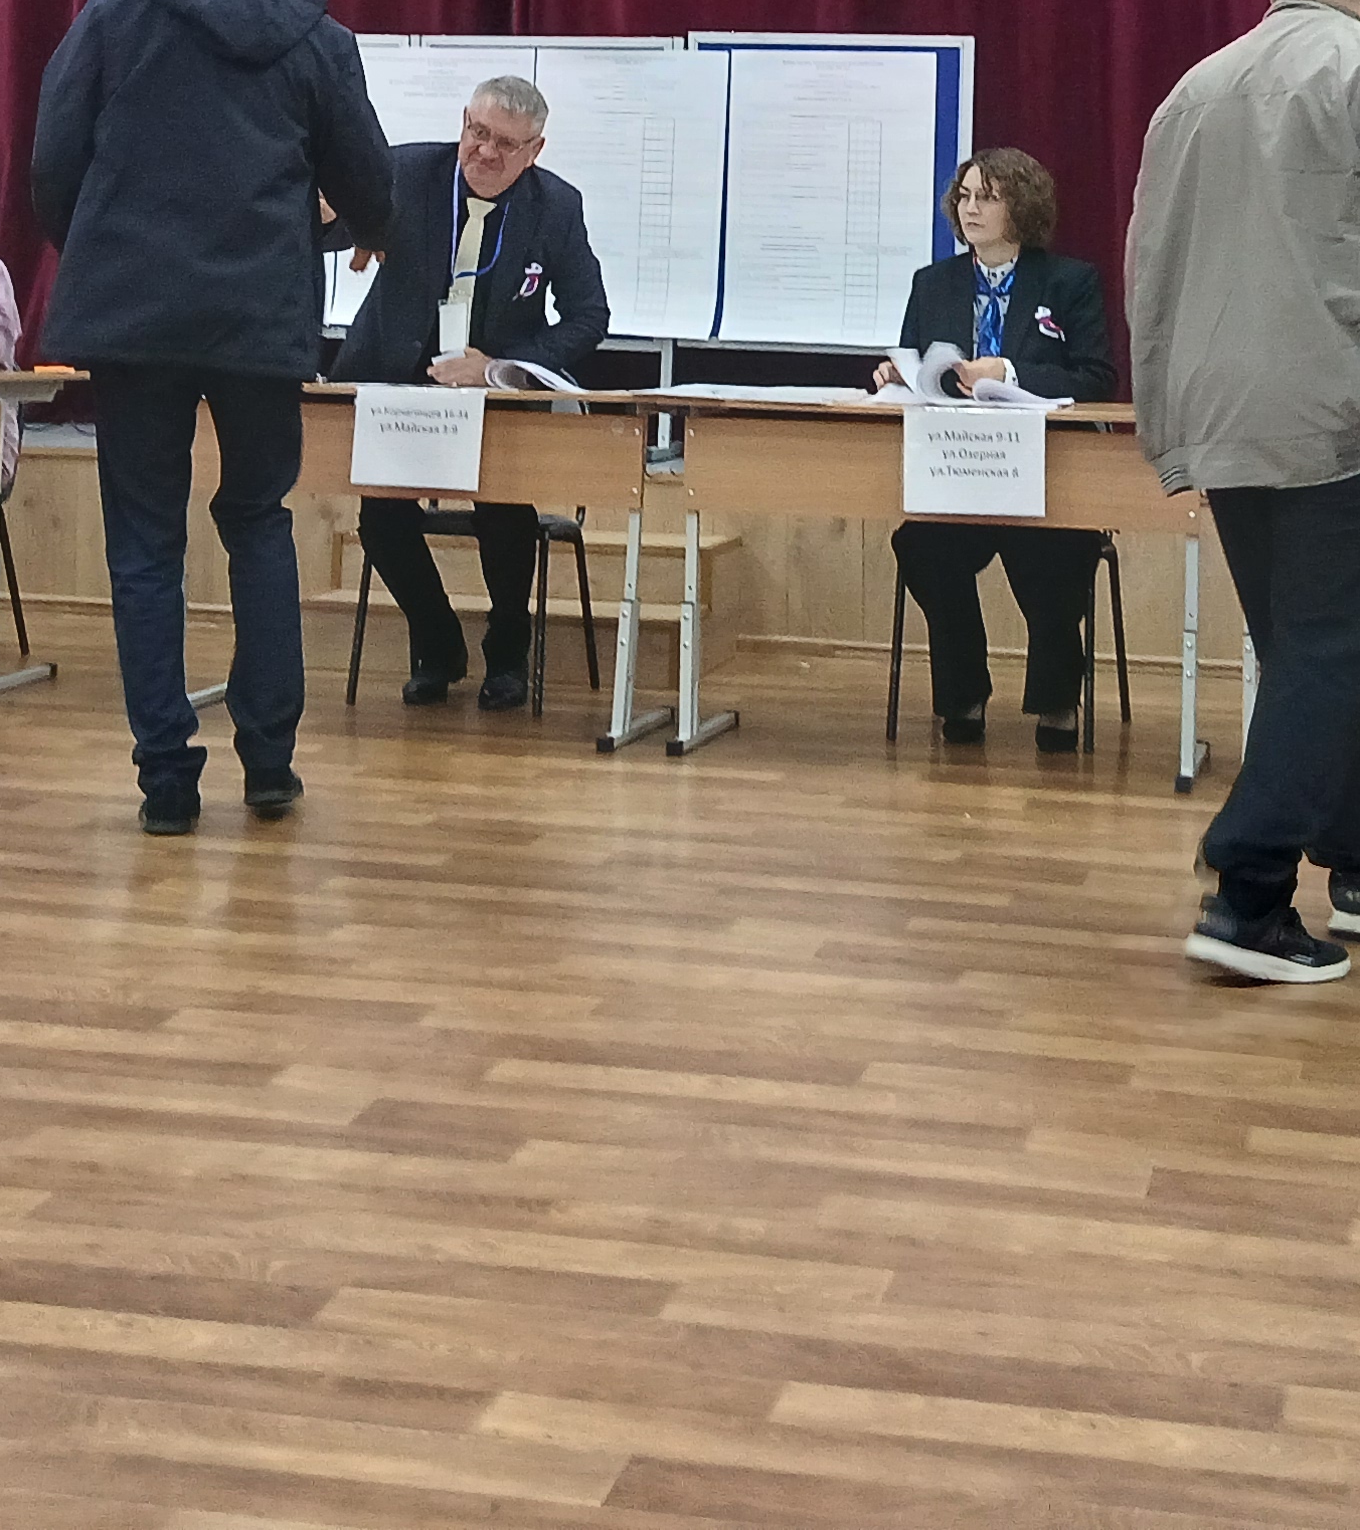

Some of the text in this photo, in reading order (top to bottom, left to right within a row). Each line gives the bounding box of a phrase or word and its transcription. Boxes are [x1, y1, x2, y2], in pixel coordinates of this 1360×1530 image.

[927, 430, 1021, 443] ул.Майская 9-11
[941, 448, 1007, 461] ул.Озерная
[929, 465, 1009, 478] ул.Тюменская
